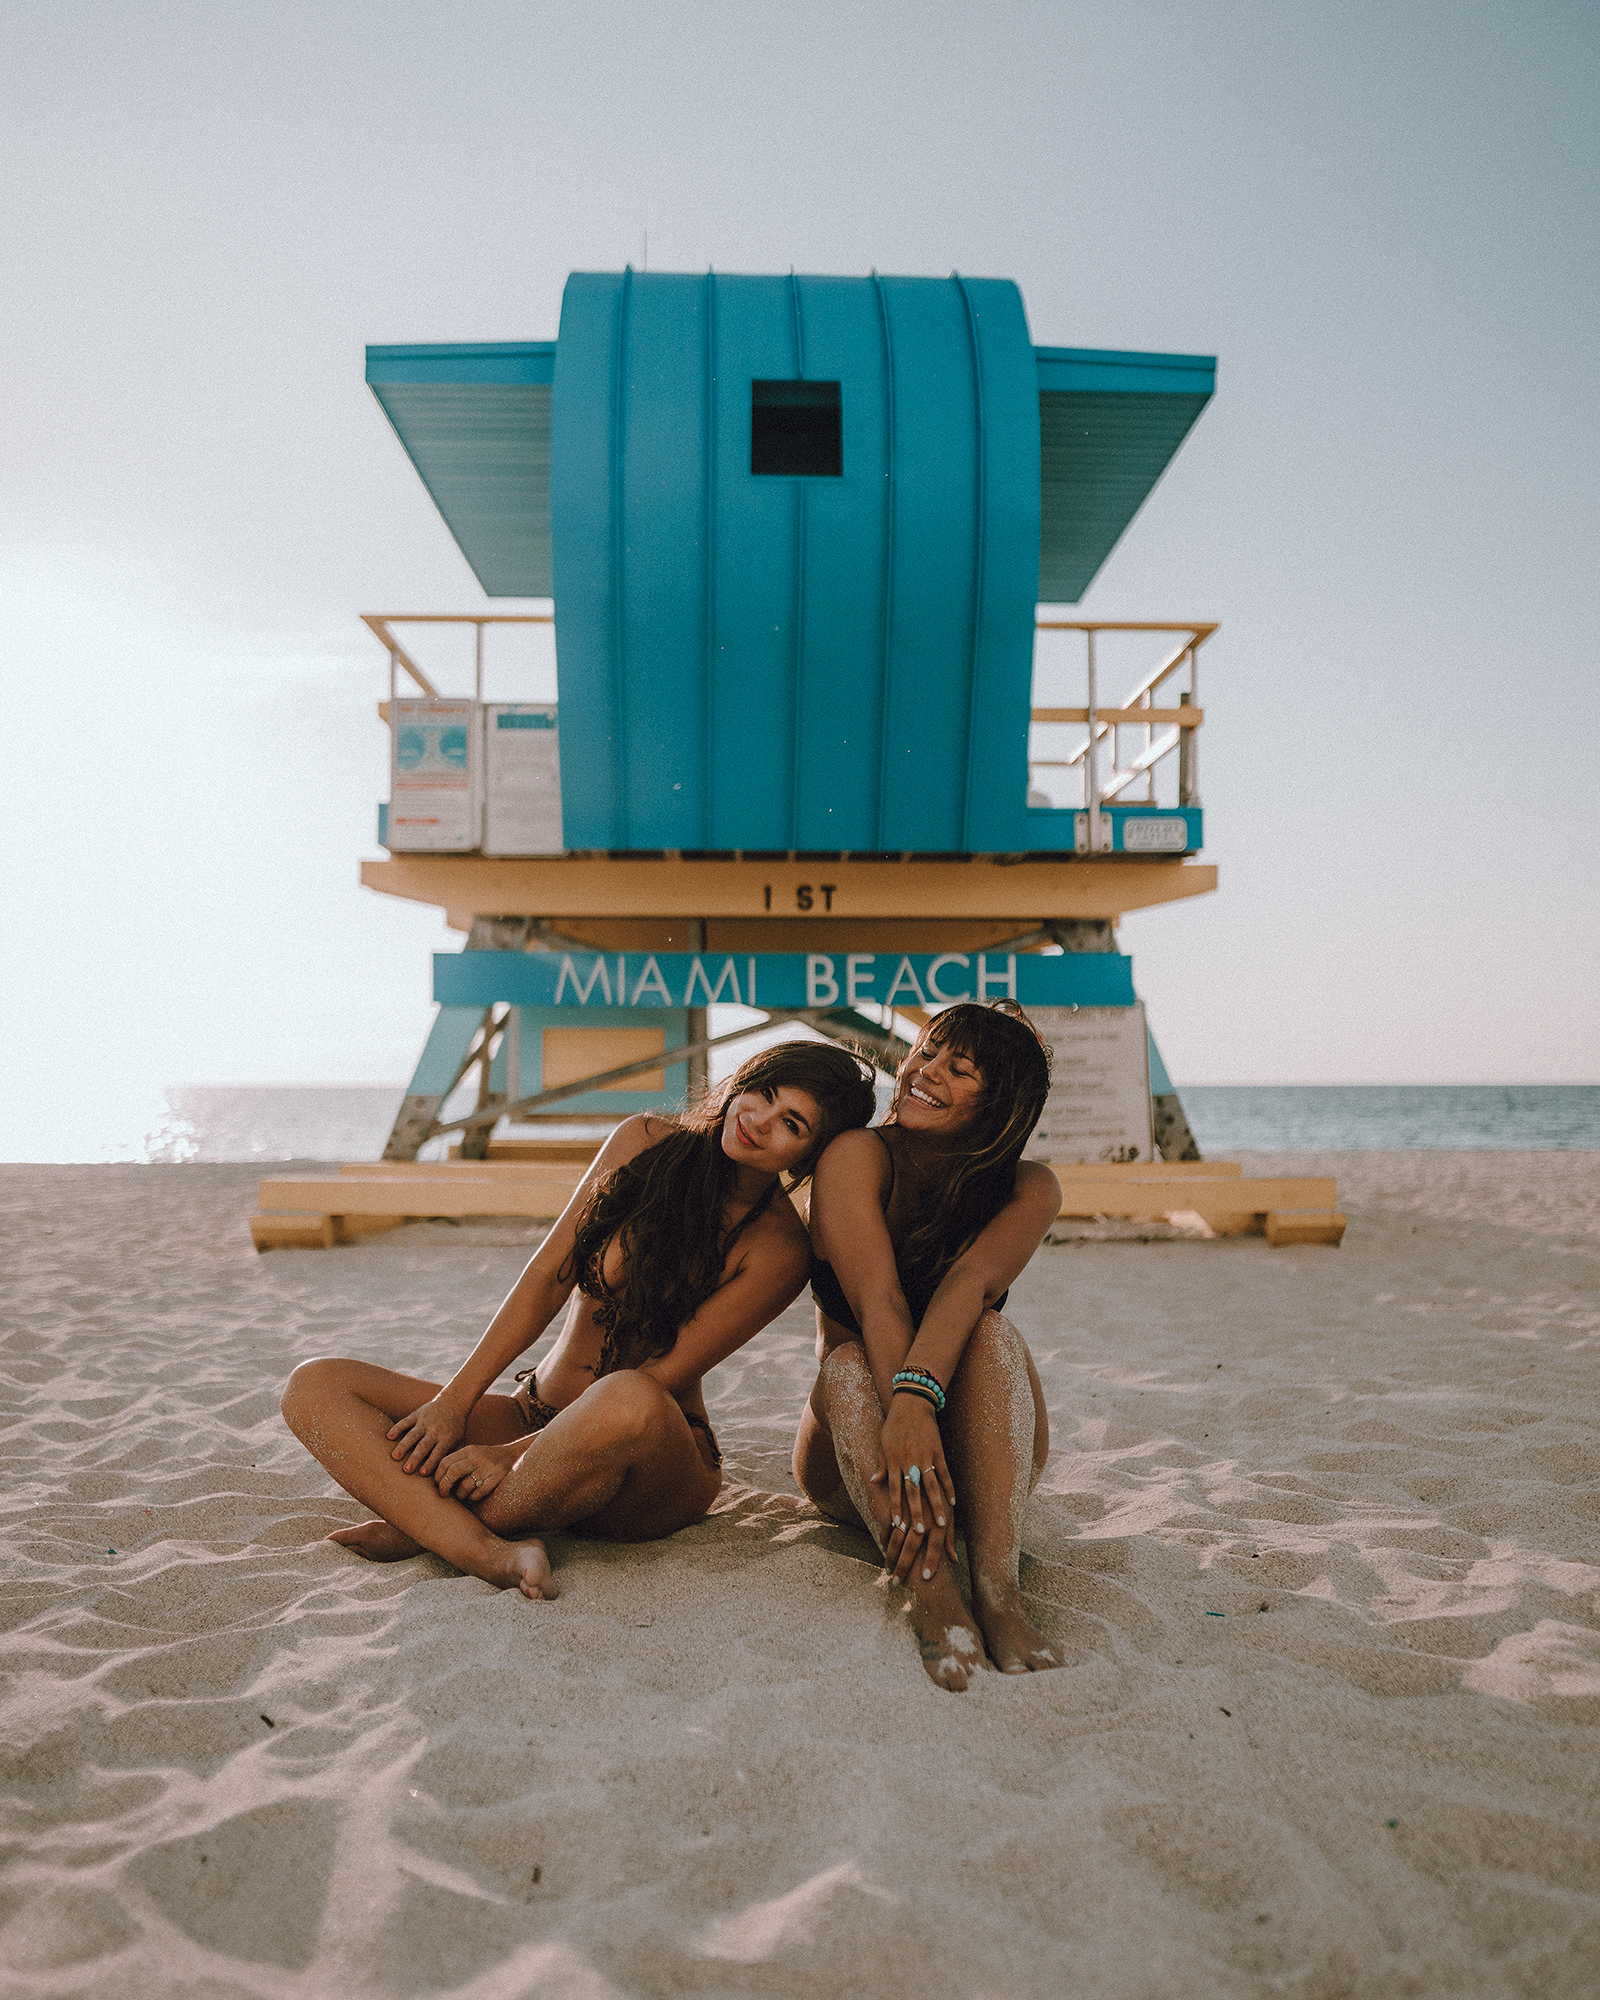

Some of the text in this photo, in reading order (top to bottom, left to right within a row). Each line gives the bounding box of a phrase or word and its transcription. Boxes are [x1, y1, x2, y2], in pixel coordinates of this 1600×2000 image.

[797, 884, 838, 911] ST
[554, 953, 1018, 1007] MIAMI BEACH
